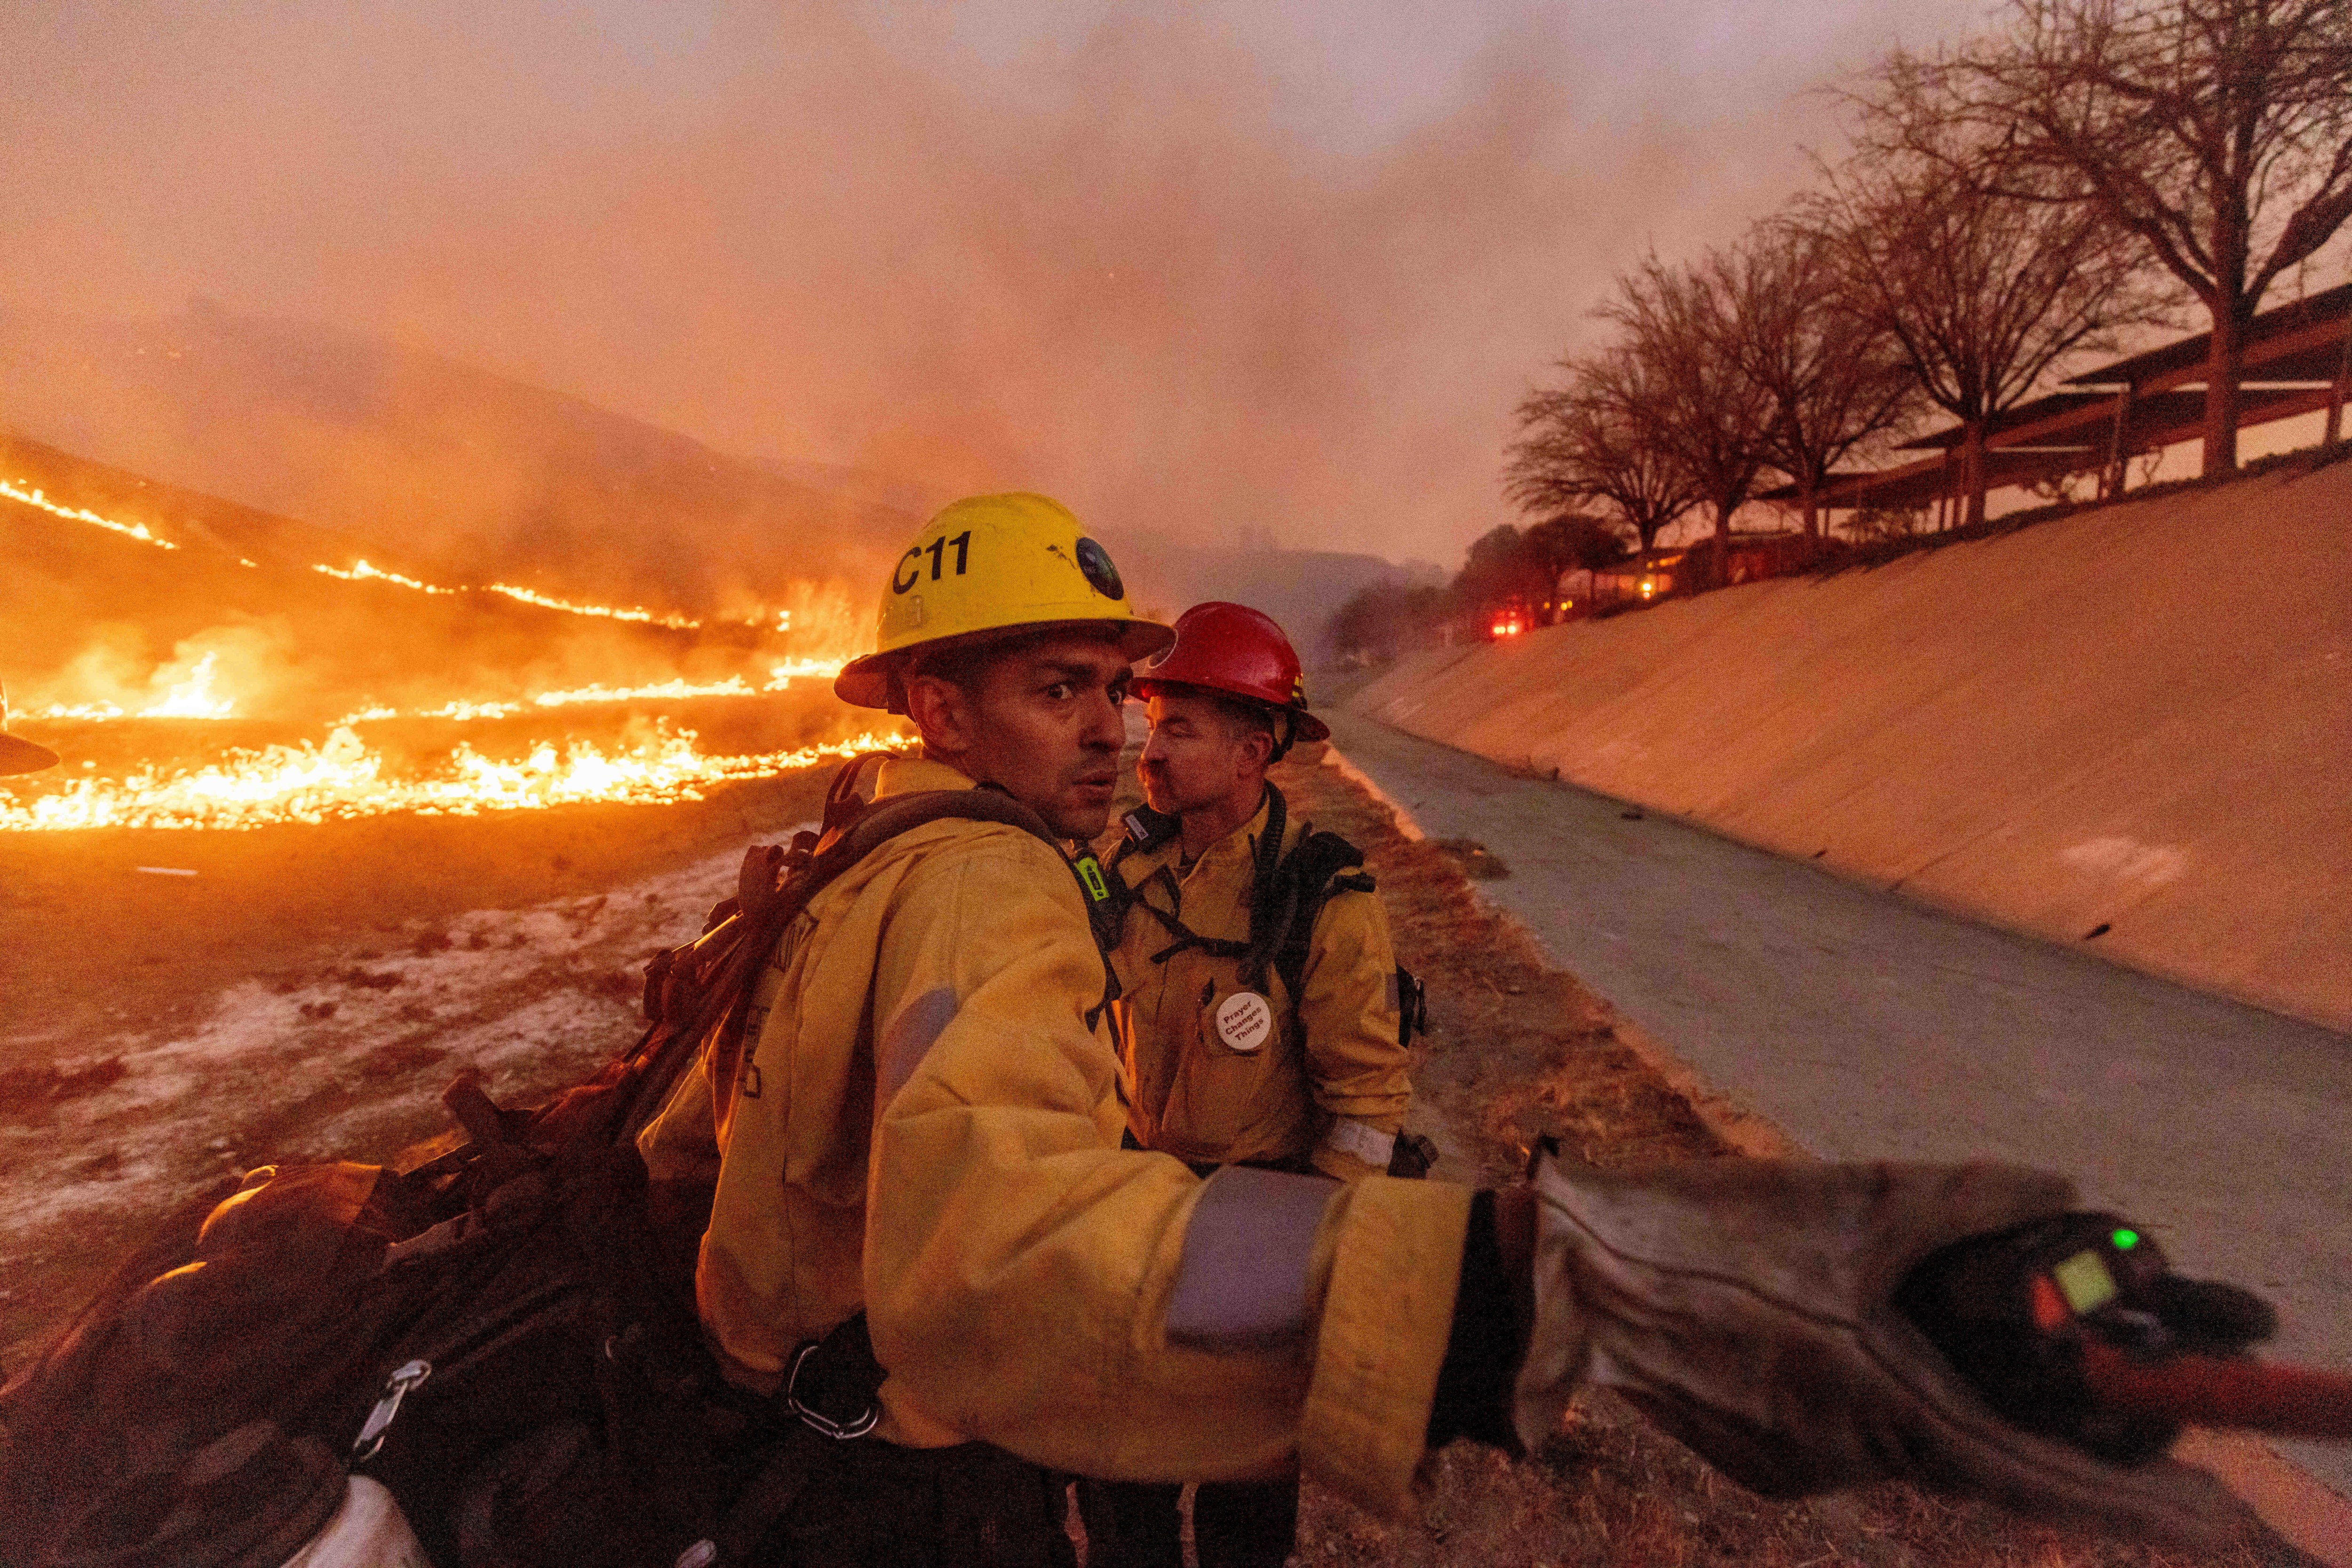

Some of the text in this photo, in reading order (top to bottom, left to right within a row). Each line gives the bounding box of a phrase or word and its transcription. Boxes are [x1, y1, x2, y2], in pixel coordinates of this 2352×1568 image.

[893, 531, 971, 595] C11
[1224, 1000, 1251, 1024] Prayer
[1225, 1006, 1262, 1035] Changes
[1235, 1018, 1264, 1041] Things
